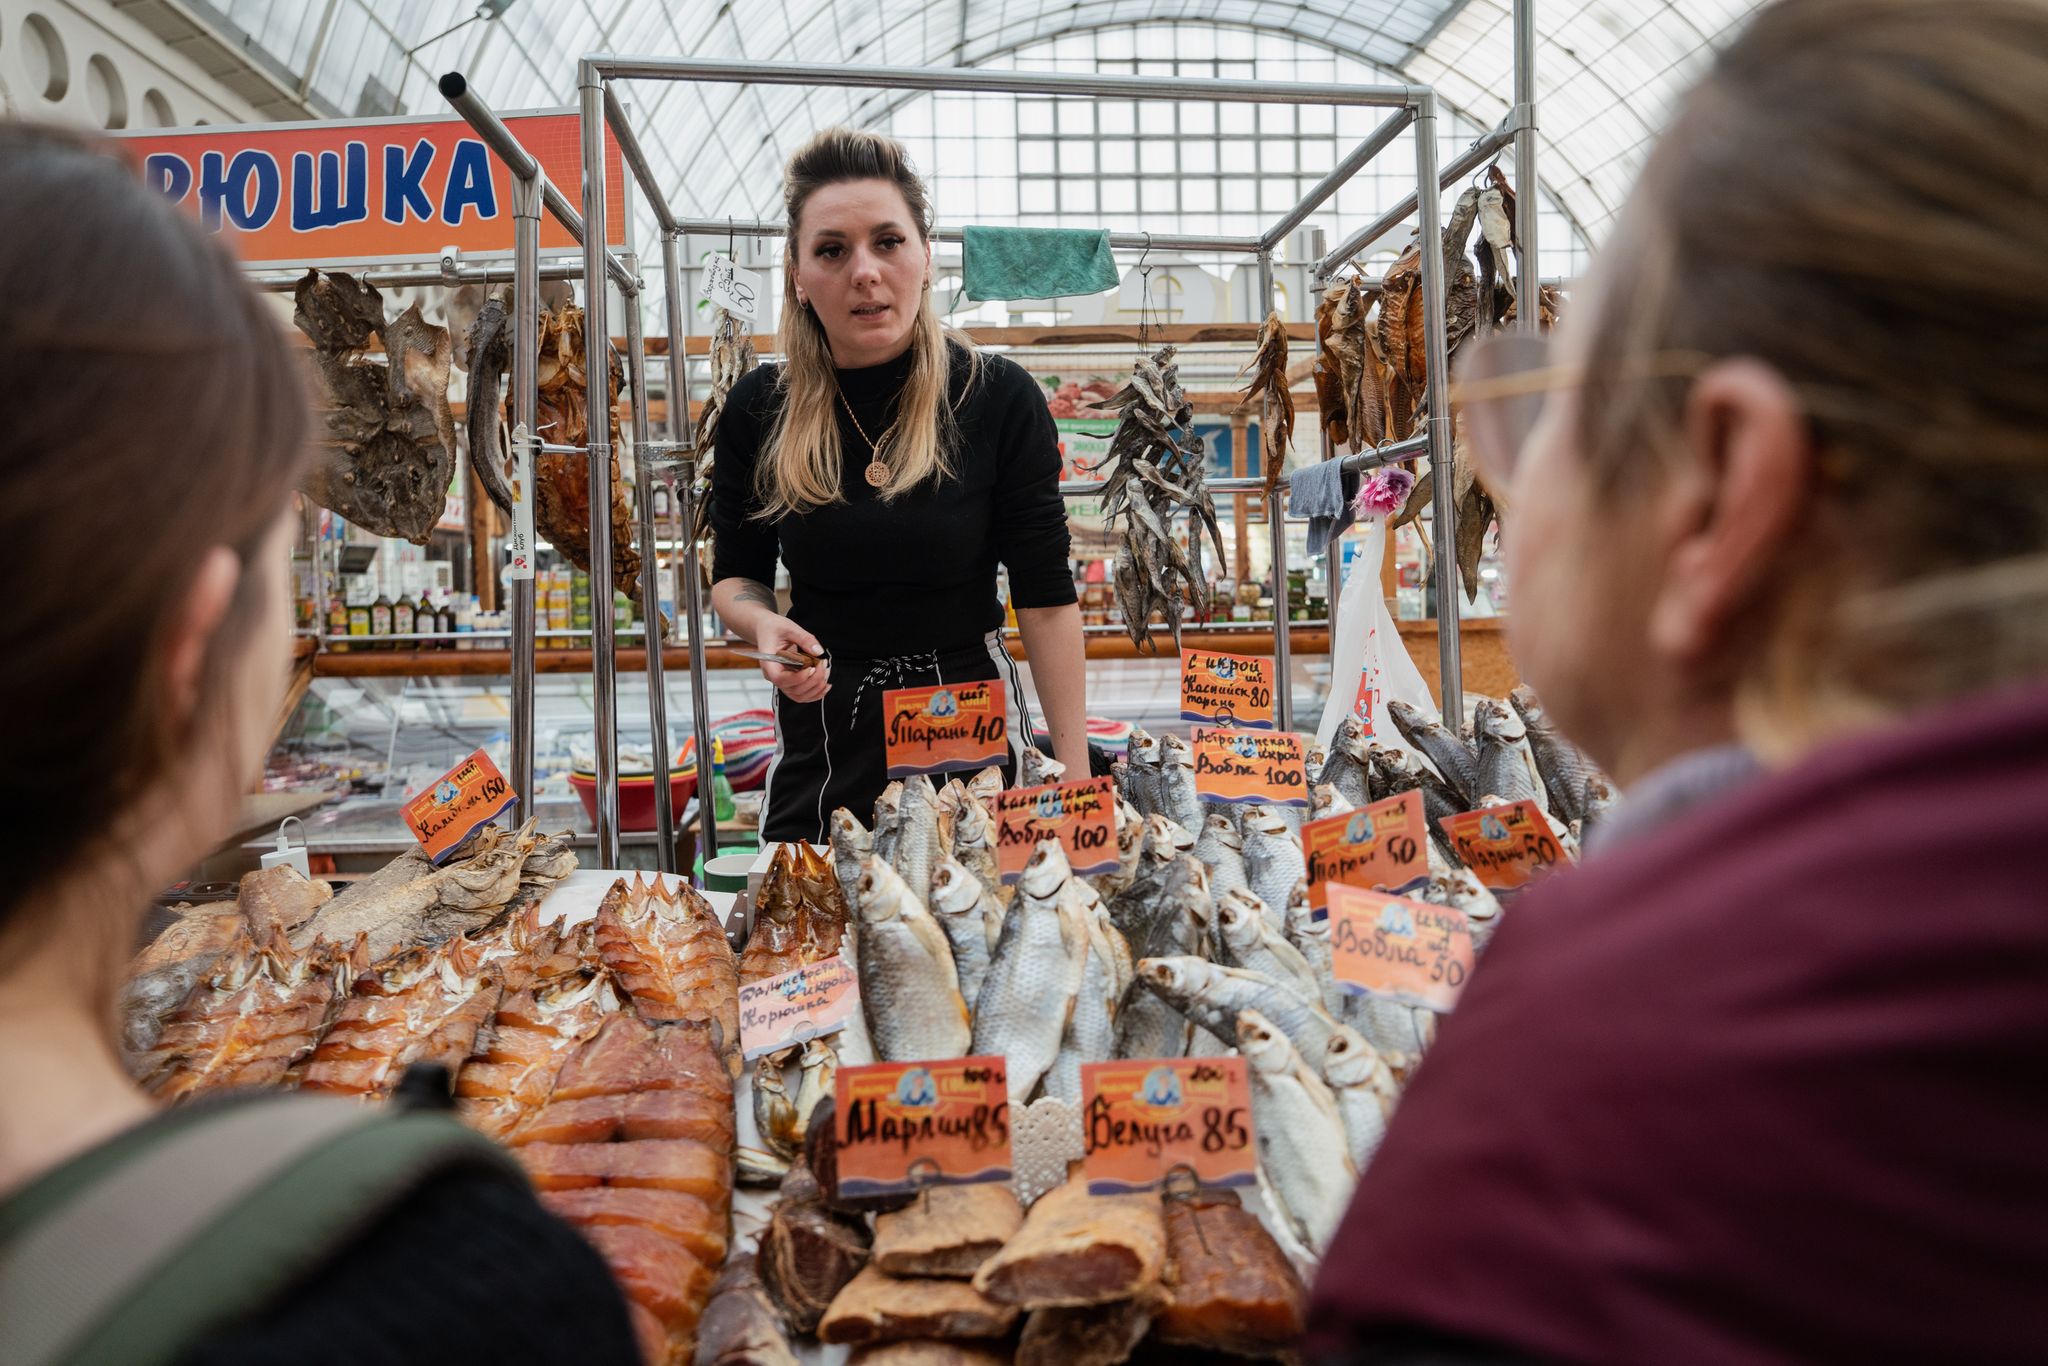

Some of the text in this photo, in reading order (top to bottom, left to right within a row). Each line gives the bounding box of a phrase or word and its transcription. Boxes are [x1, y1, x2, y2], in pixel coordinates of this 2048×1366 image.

[729, 282, 755, 313] 50
[1206, 657, 1260, 674] икрой
[1187, 693, 1236, 709] тарань
[1250, 686, 1270, 708] 80
[888, 710, 1005, 751] Тарань 40
[1193, 727, 1295, 748] Астраханская
[1195, 753, 1303, 786] Вобла 100
[1257, 745, 1301, 765] икрой
[416, 776, 506, 844] Камбла 150
[997, 782, 1110, 812] Каспийская
[1060, 799, 1103, 820] икра
[1072, 825, 1109, 851] 100
[1387, 835, 1417, 865] 50
[1458, 832, 1557, 871] Тарань 50
[1332, 918, 1464, 987] Вобла 50
[803, 971, 854, 996] икрой
[741, 996, 830, 1031] Корюшка
[839, 1098, 1009, 1155] Марлин 85
[1085, 1093, 1248, 1158] Белуга 85
